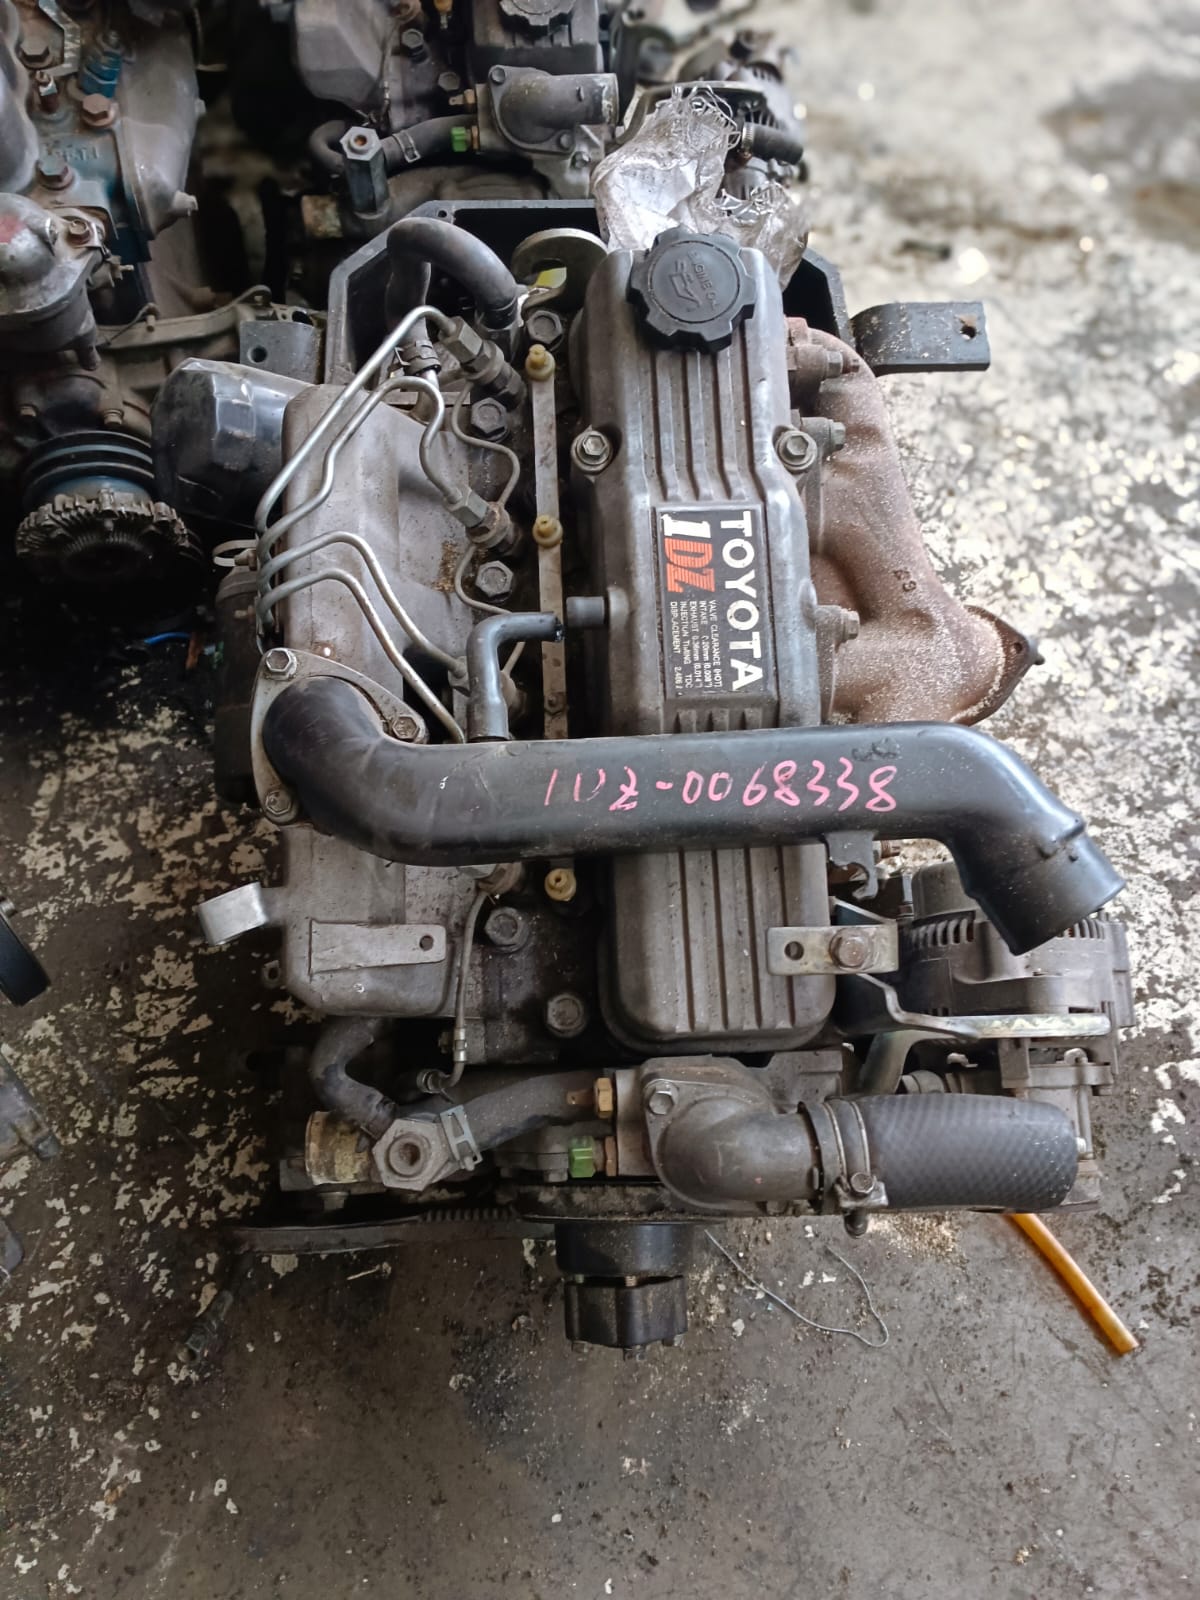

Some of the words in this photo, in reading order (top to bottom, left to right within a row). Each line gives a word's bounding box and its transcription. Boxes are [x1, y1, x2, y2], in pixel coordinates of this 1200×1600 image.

[660, 514, 716, 593] 1DZ
[689, 600, 699, 632] EXHAUST
[699, 600, 708, 625] INTAKE
[709, 600, 717, 621] VALVE
[720, 511, 764, 691] TOYOTA
[680, 601, 689, 637] INJECTION
[685, 674, 693, 688] TDC
[711, 624, 721, 666] CLEARANCE
